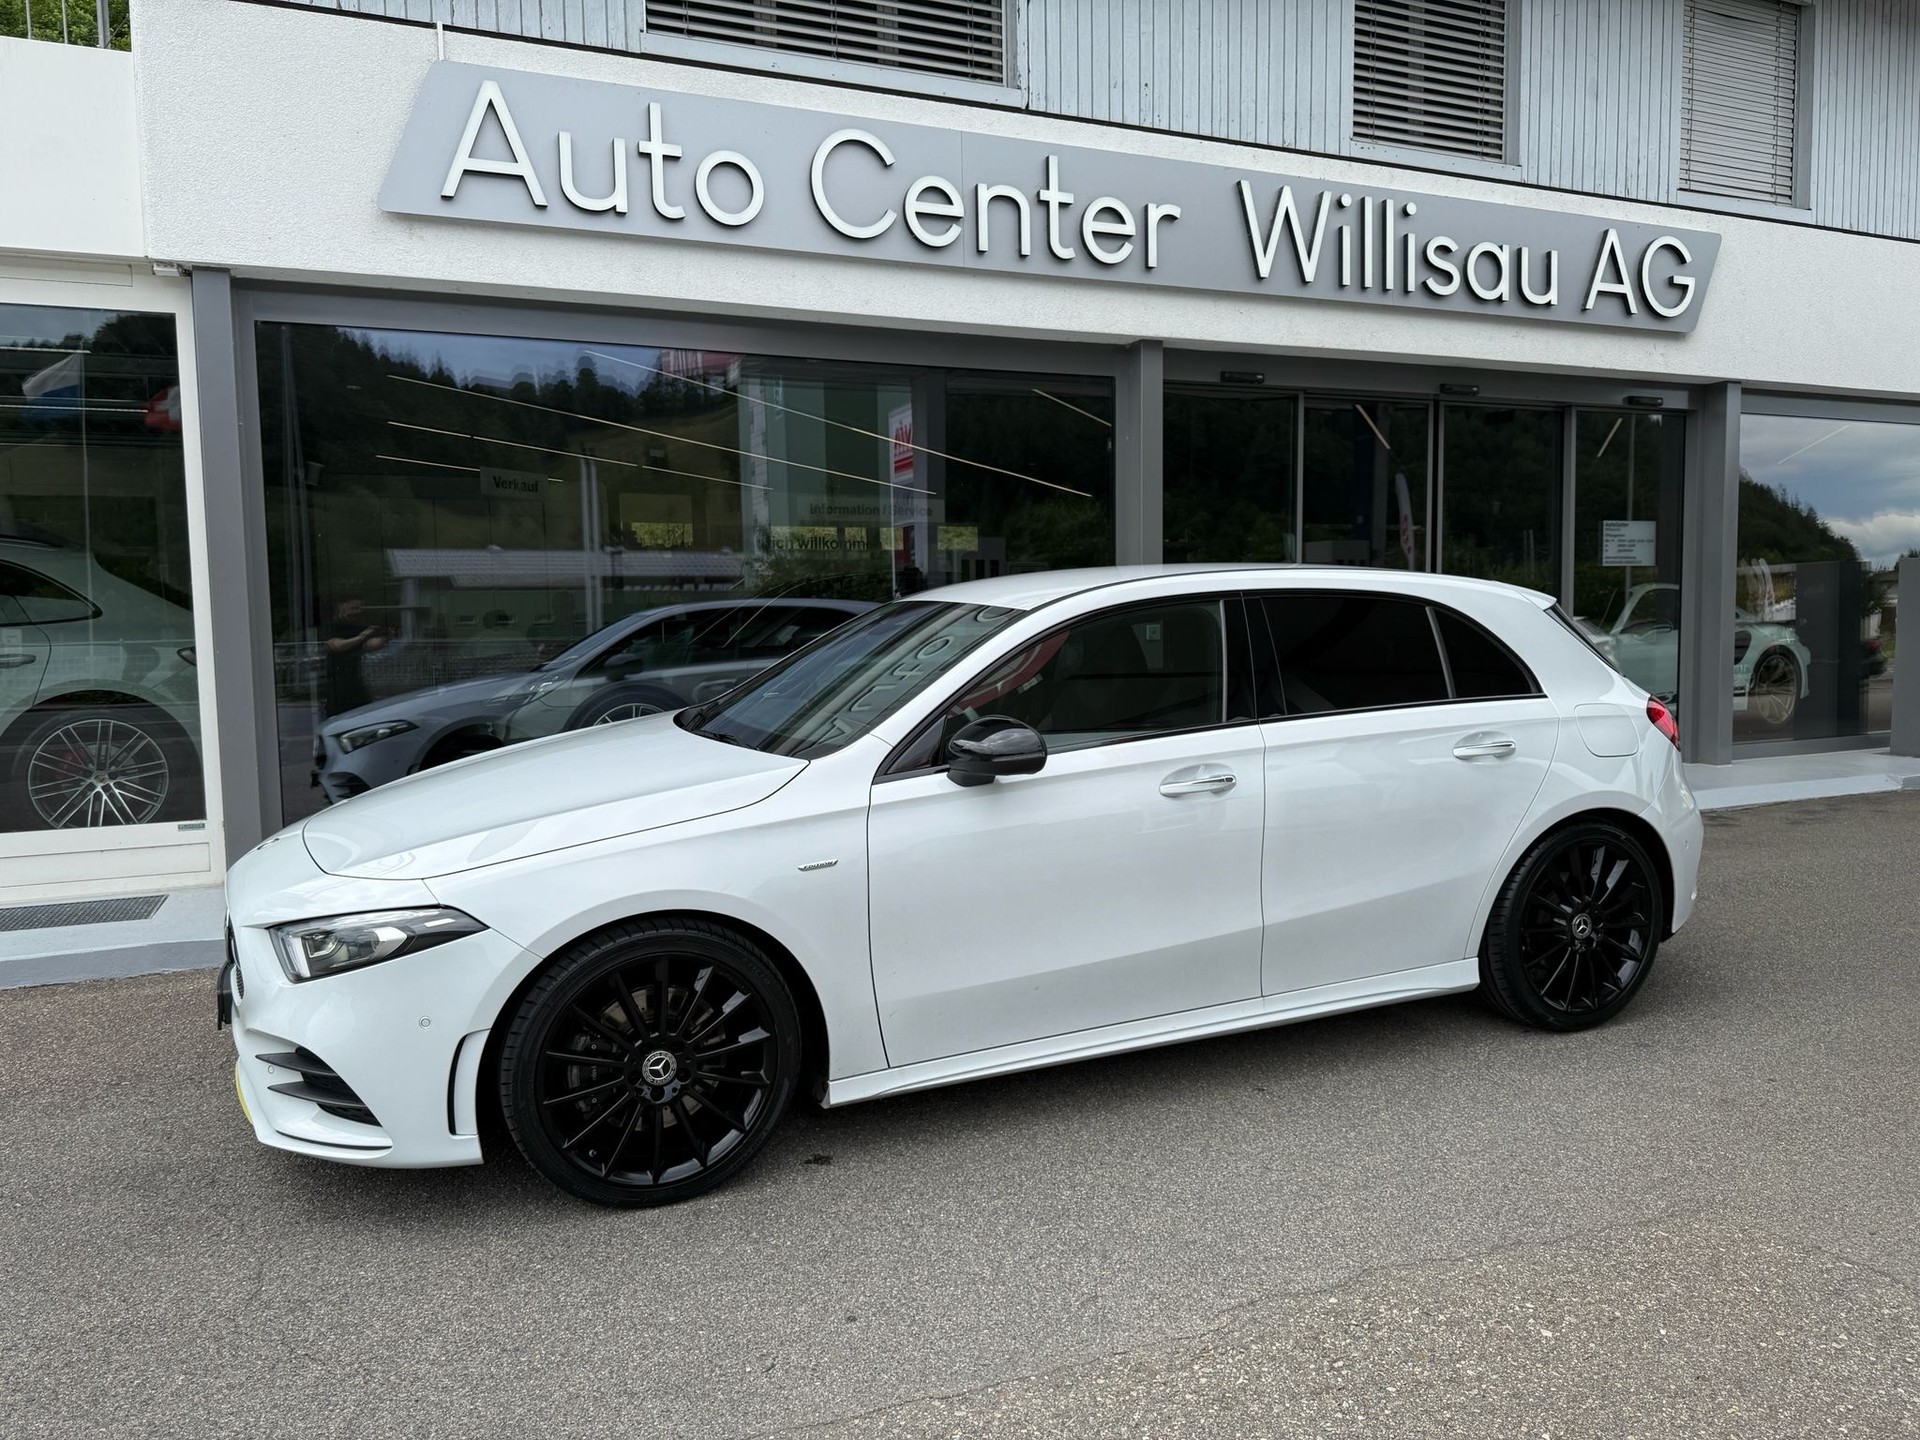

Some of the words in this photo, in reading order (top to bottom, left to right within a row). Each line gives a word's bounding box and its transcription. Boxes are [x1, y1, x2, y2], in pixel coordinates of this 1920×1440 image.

[440, 79, 765, 227] Auto
[810, 128, 1182, 270] Center
[1236, 179, 1559, 306] Willisau
[1581, 228, 1697, 319] AG
[493, 475, 538, 492] Verkauf
[810, 503, 879, 516] Information
[891, 504, 934, 517] Service
